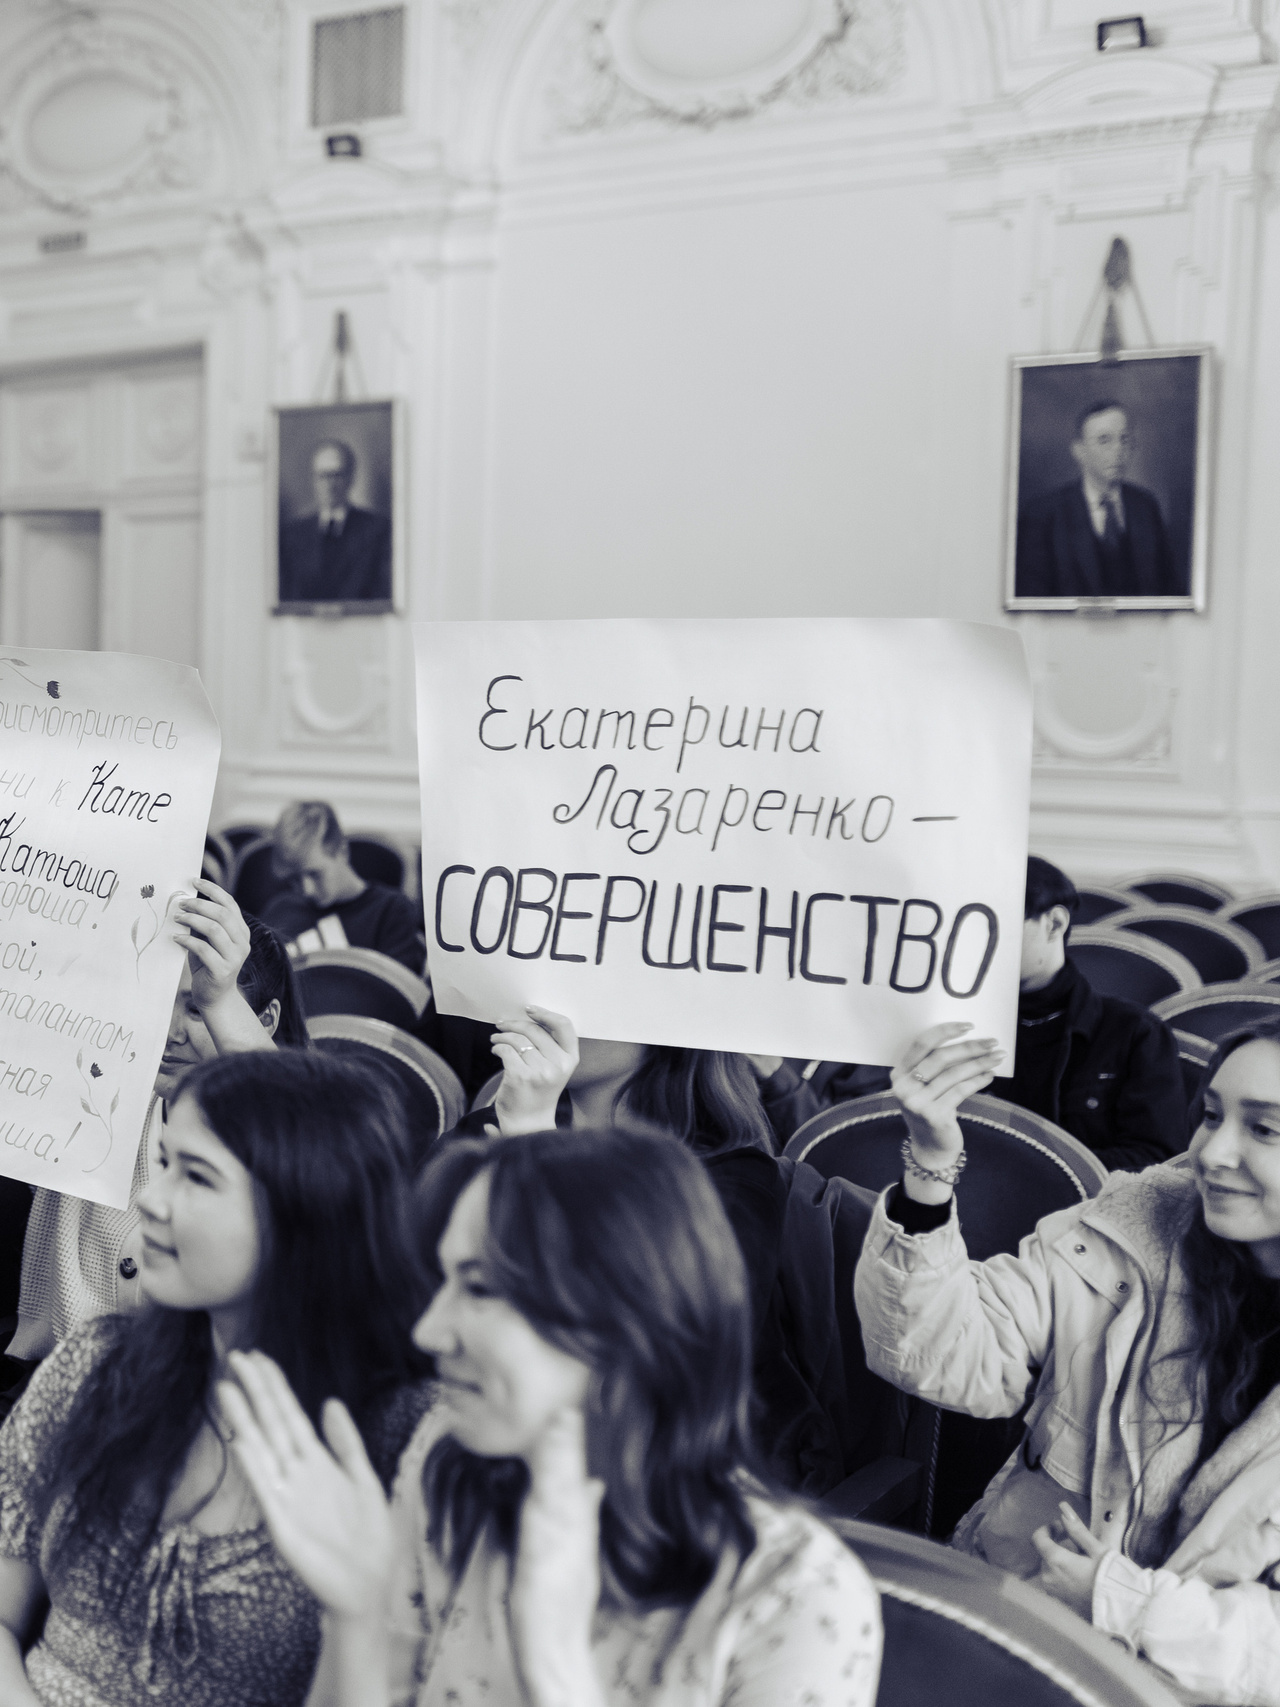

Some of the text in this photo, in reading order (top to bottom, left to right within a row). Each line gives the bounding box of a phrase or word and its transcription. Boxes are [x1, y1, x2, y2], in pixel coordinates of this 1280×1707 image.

[478, 674, 825, 773] Екатерина
[47, 778, 74, 808] к
[76, 759, 173, 823] Кате
[552, 763, 895, 855] Лазаренко
[435, 864, 999, 1000] СОВЕРШЕНСТВО
